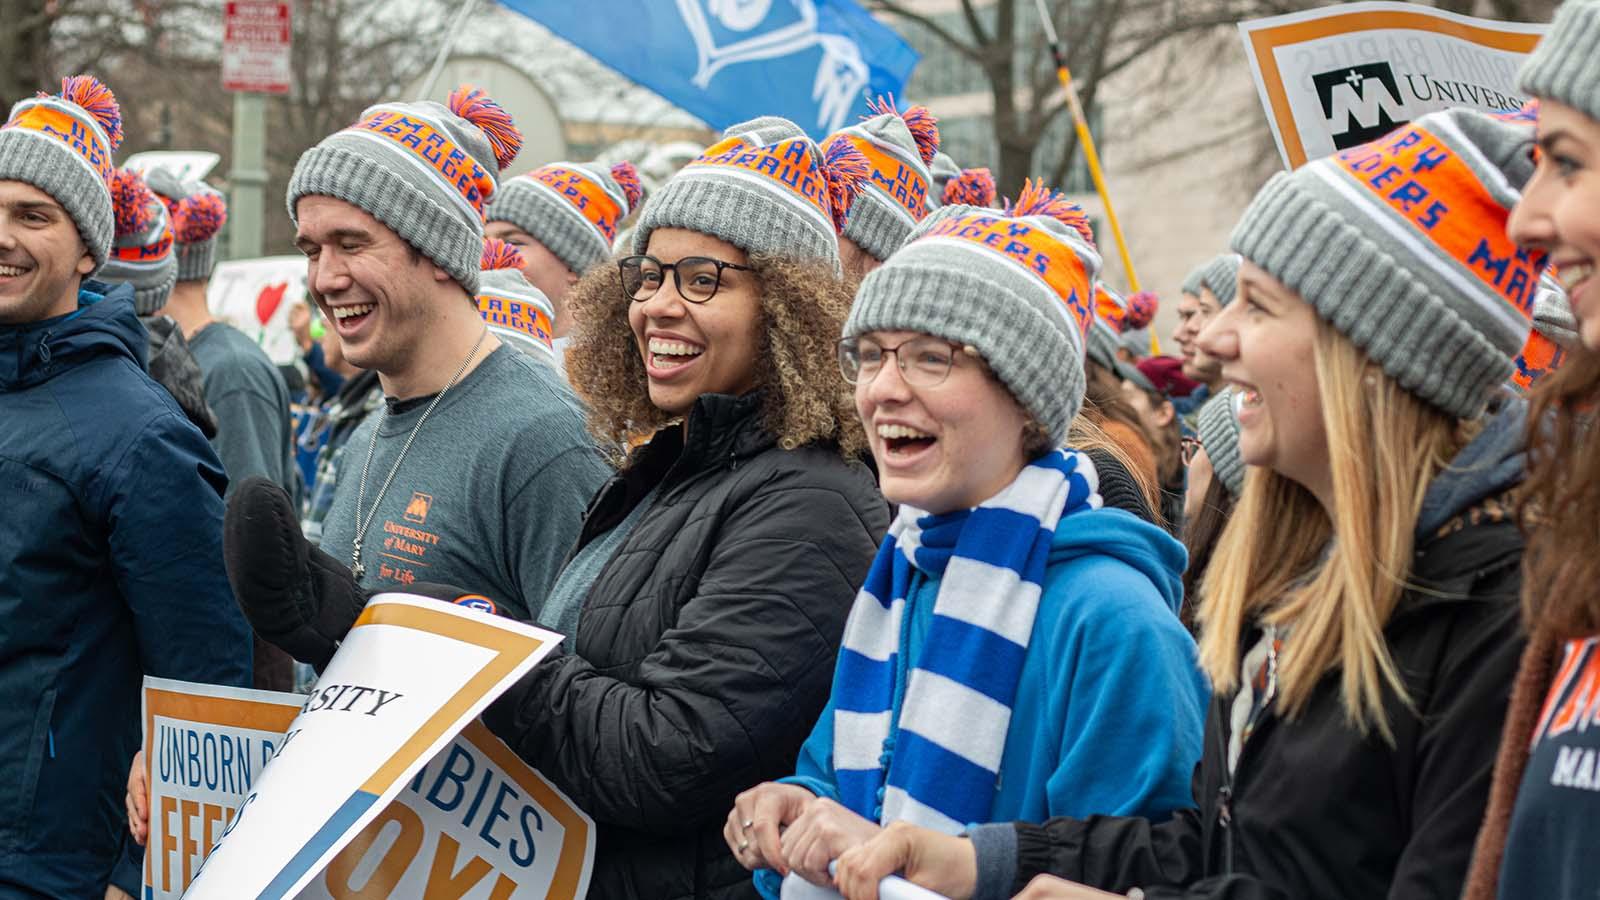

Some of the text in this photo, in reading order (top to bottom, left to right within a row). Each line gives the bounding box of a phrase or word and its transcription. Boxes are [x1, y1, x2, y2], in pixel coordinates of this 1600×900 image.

[384, 520, 440, 546] UNIVERSITY
[394, 536, 426, 556] MARY
[159, 724, 251, 796] UNBORN
